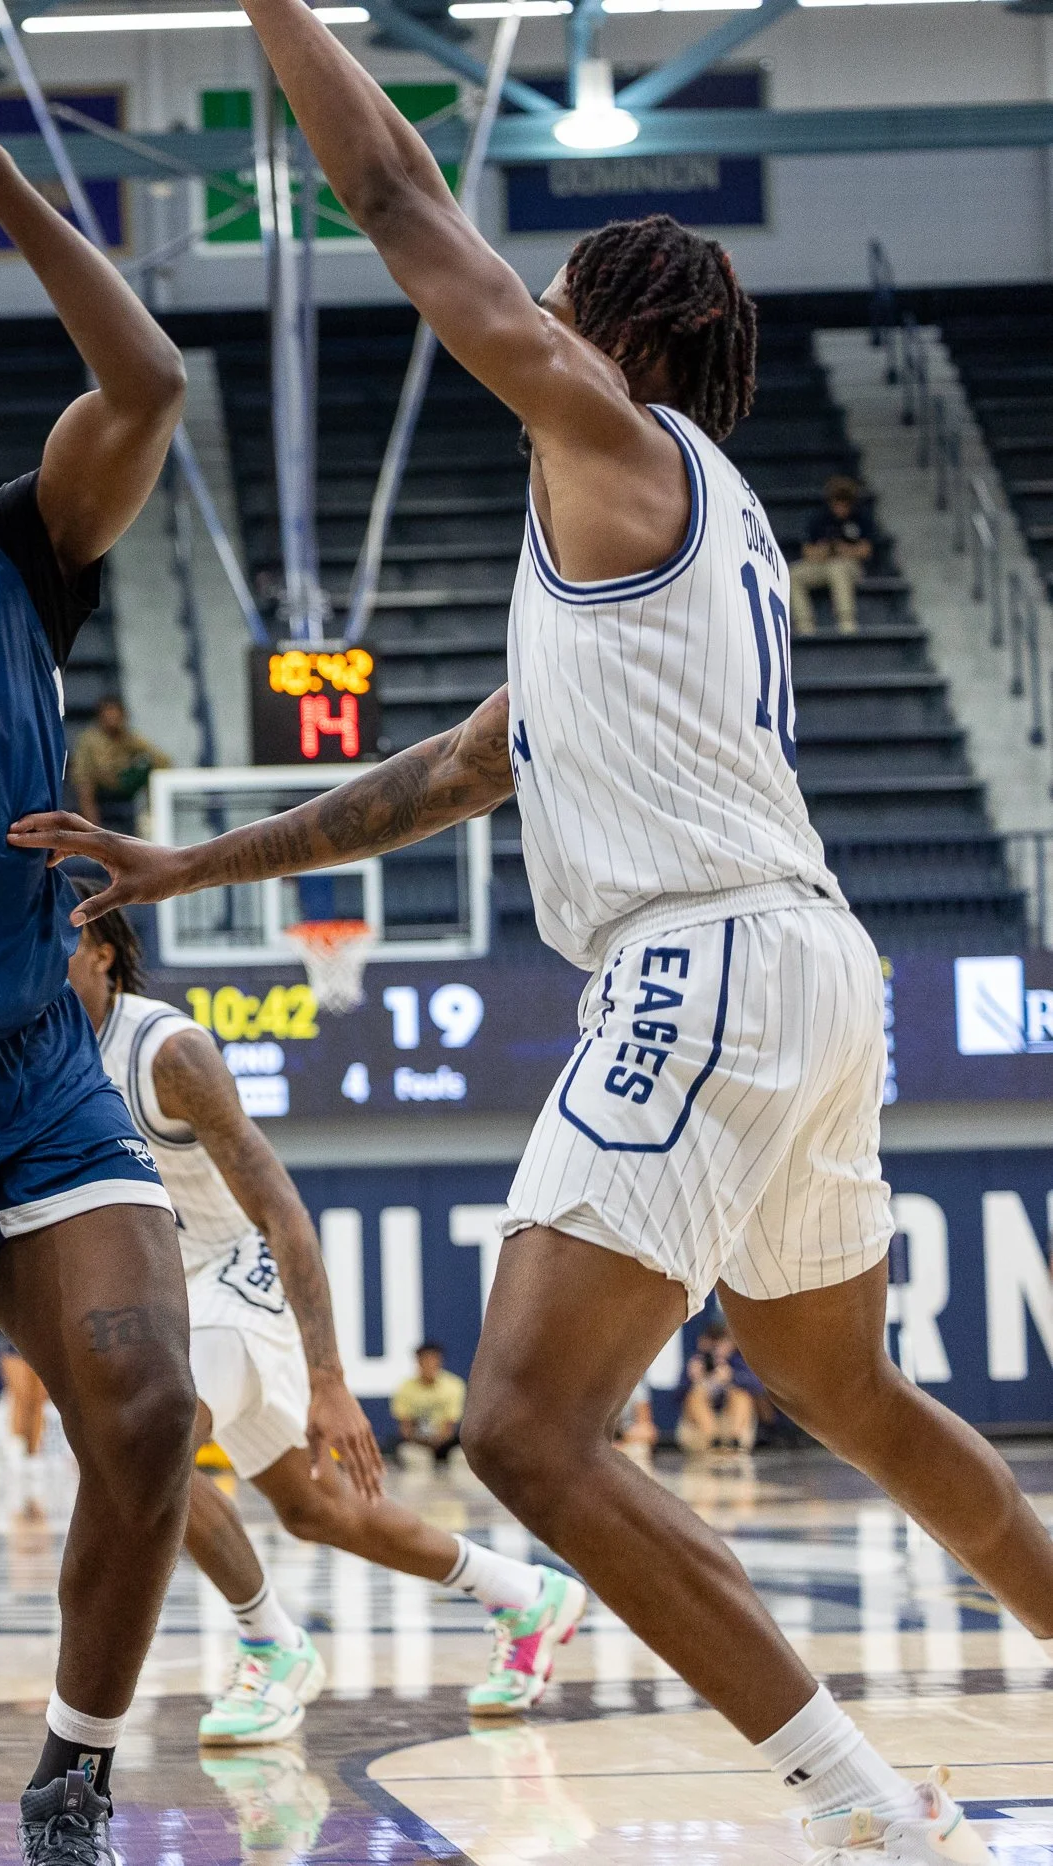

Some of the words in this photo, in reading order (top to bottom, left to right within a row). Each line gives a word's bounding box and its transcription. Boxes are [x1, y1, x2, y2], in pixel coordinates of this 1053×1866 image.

[740, 560, 797, 773] 10
[299, 693, 360, 759] 14
[186, 984, 320, 1042] 10:42
[382, 982, 485, 1050] 19
[341, 1061, 372, 1104] 4
